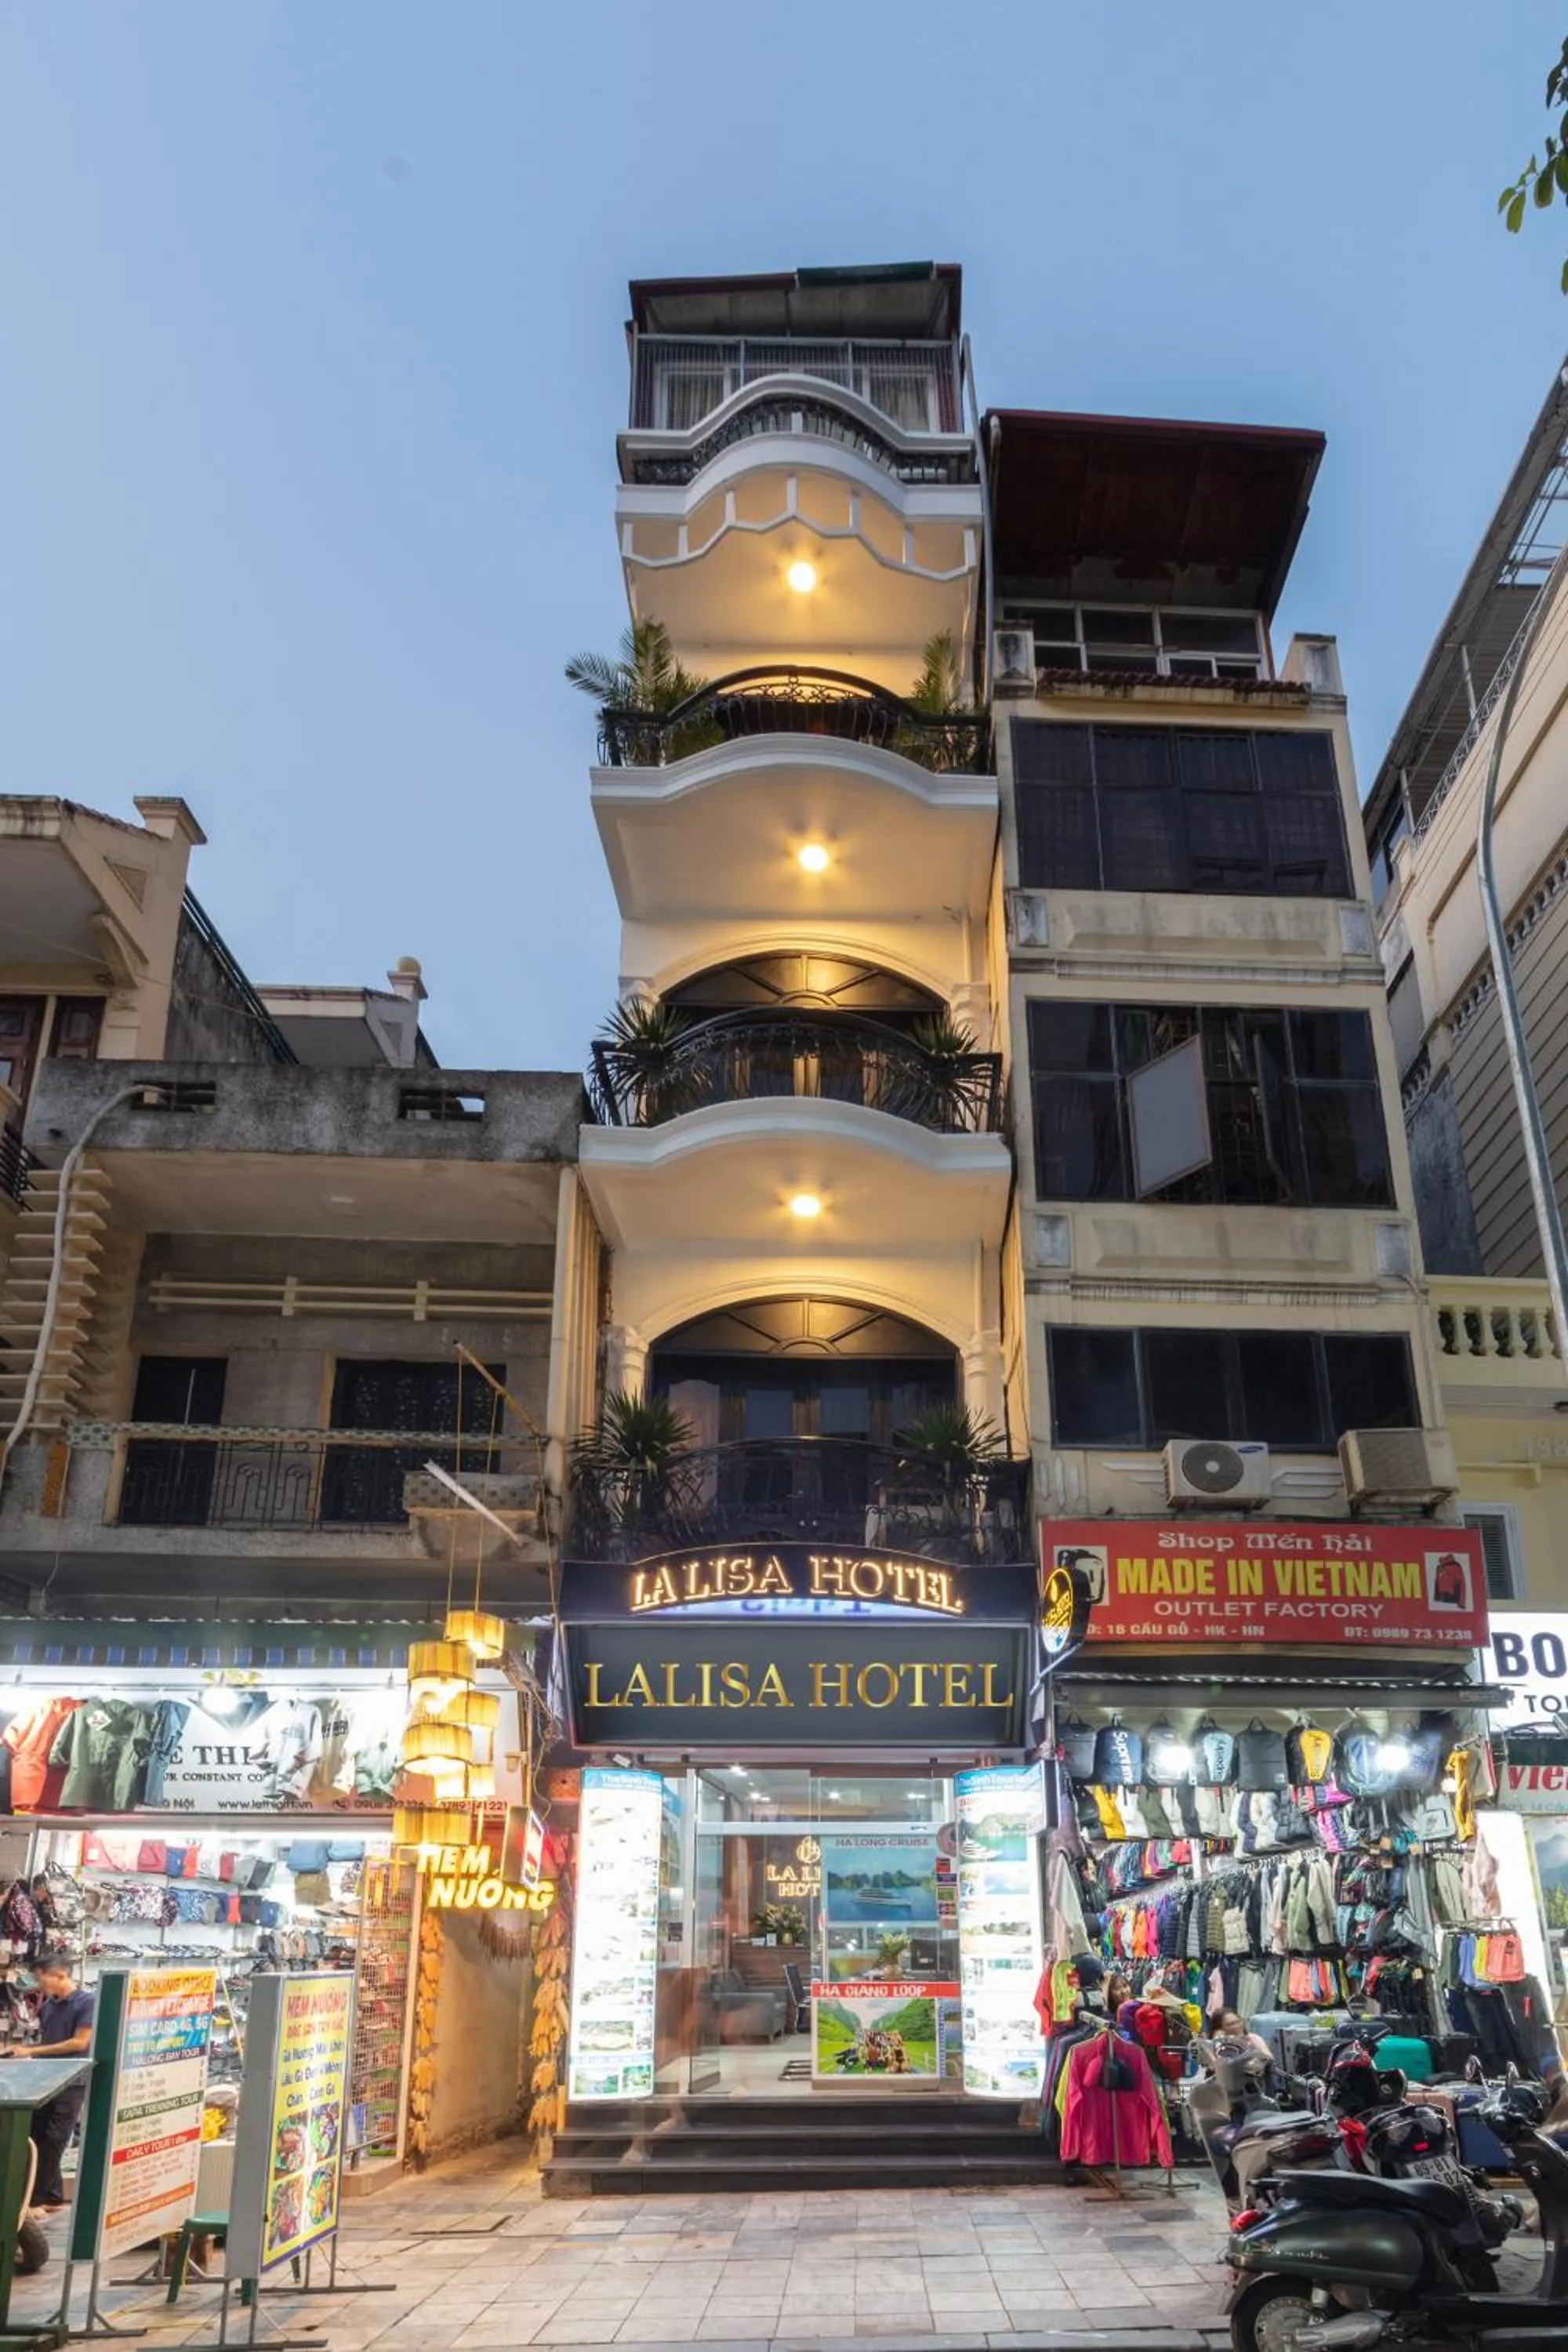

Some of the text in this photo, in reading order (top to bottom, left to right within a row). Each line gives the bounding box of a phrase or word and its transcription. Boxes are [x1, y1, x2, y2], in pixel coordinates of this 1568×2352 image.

[1158, 1533, 1234, 1552] Shop
[630, 1555, 964, 1613] LALISA HOTEL
[1116, 1558, 1422, 1599] MADE IN VIETNAM
[1153, 1601, 1385, 1618] OUTLET FACTORY
[583, 1663, 1014, 1707] LALISA HOTEL
[1524, 1694, 1568, 1713] TO
[183, 1772, 242, 1783] CONSTANT
[836, 1837, 930, 1847] HA LONG CRUISE
[767, 1864, 797, 1882] LA
[778, 1883, 822, 1897] HOT
[820, 1985, 841, 1997] HA
[893, 1985, 927, 1997] LOOP
